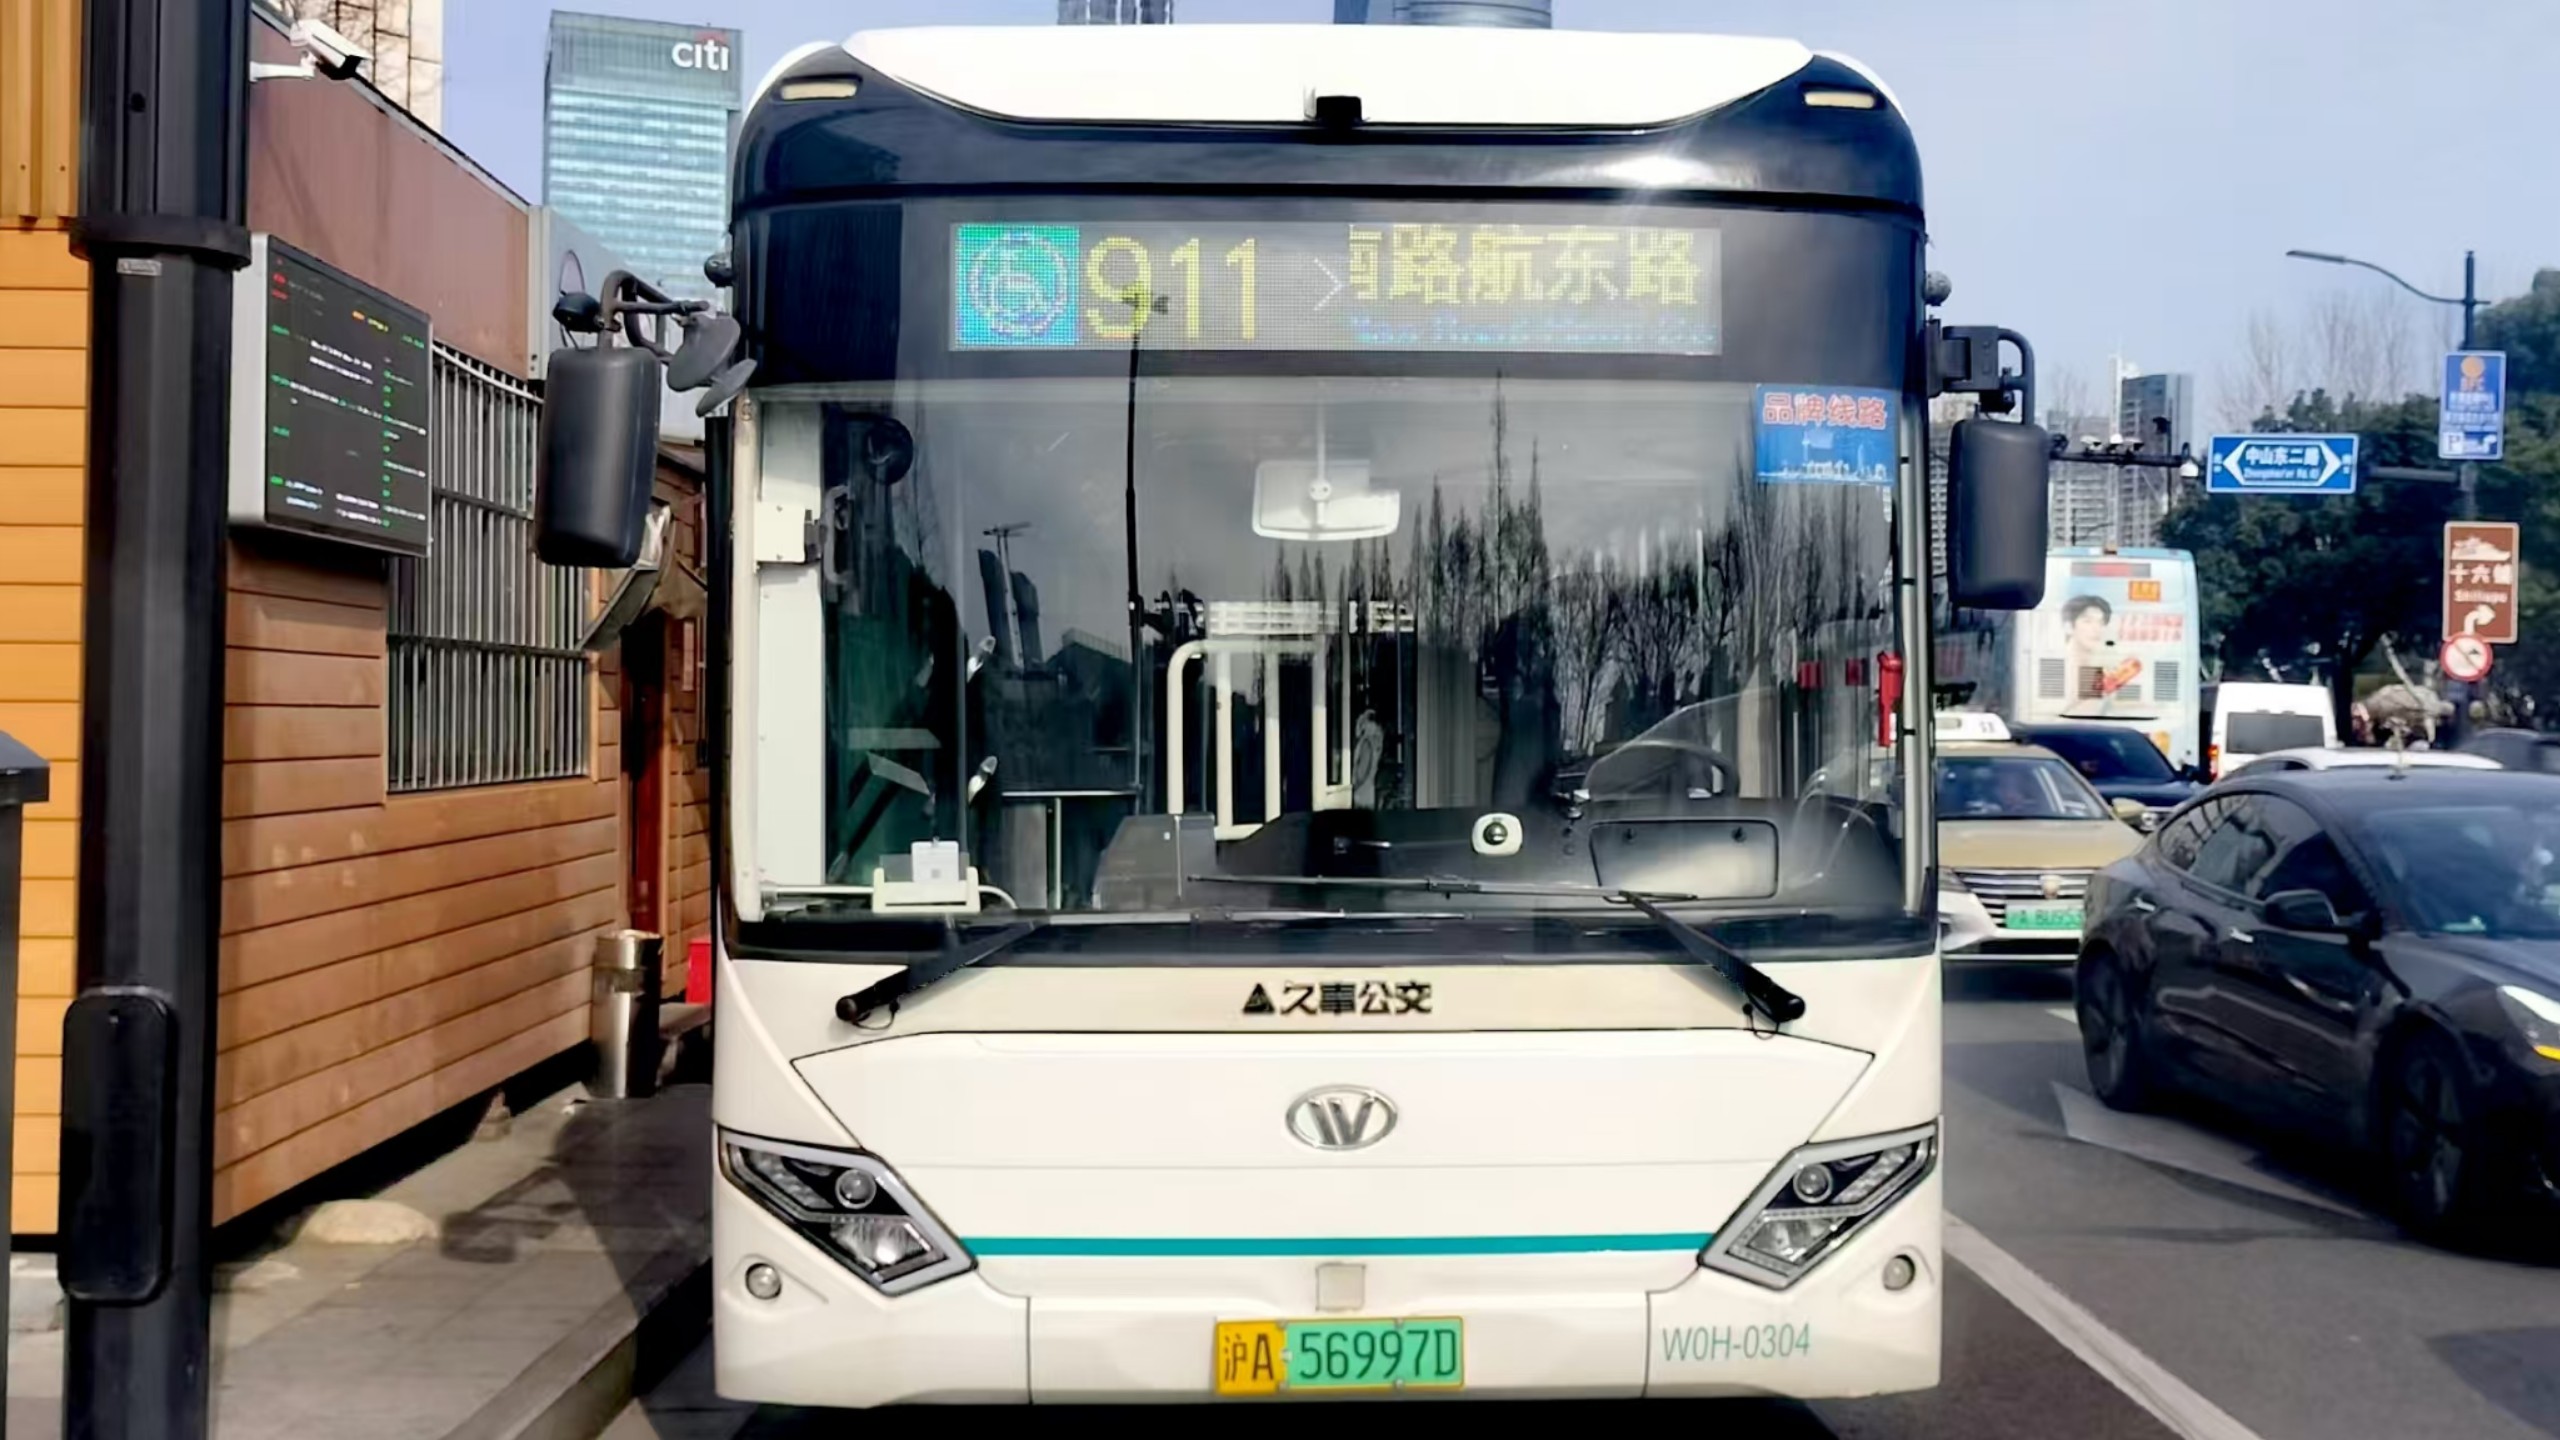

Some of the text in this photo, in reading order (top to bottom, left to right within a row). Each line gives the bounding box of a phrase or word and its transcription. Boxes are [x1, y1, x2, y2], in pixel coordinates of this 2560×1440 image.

[671, 39, 730, 72] citi
[1086, 236, 1258, 341] 911
[1762, 391, 1888, 431] 品牌线路
[1223, 1327, 1457, 1382] 沪A 56997D
